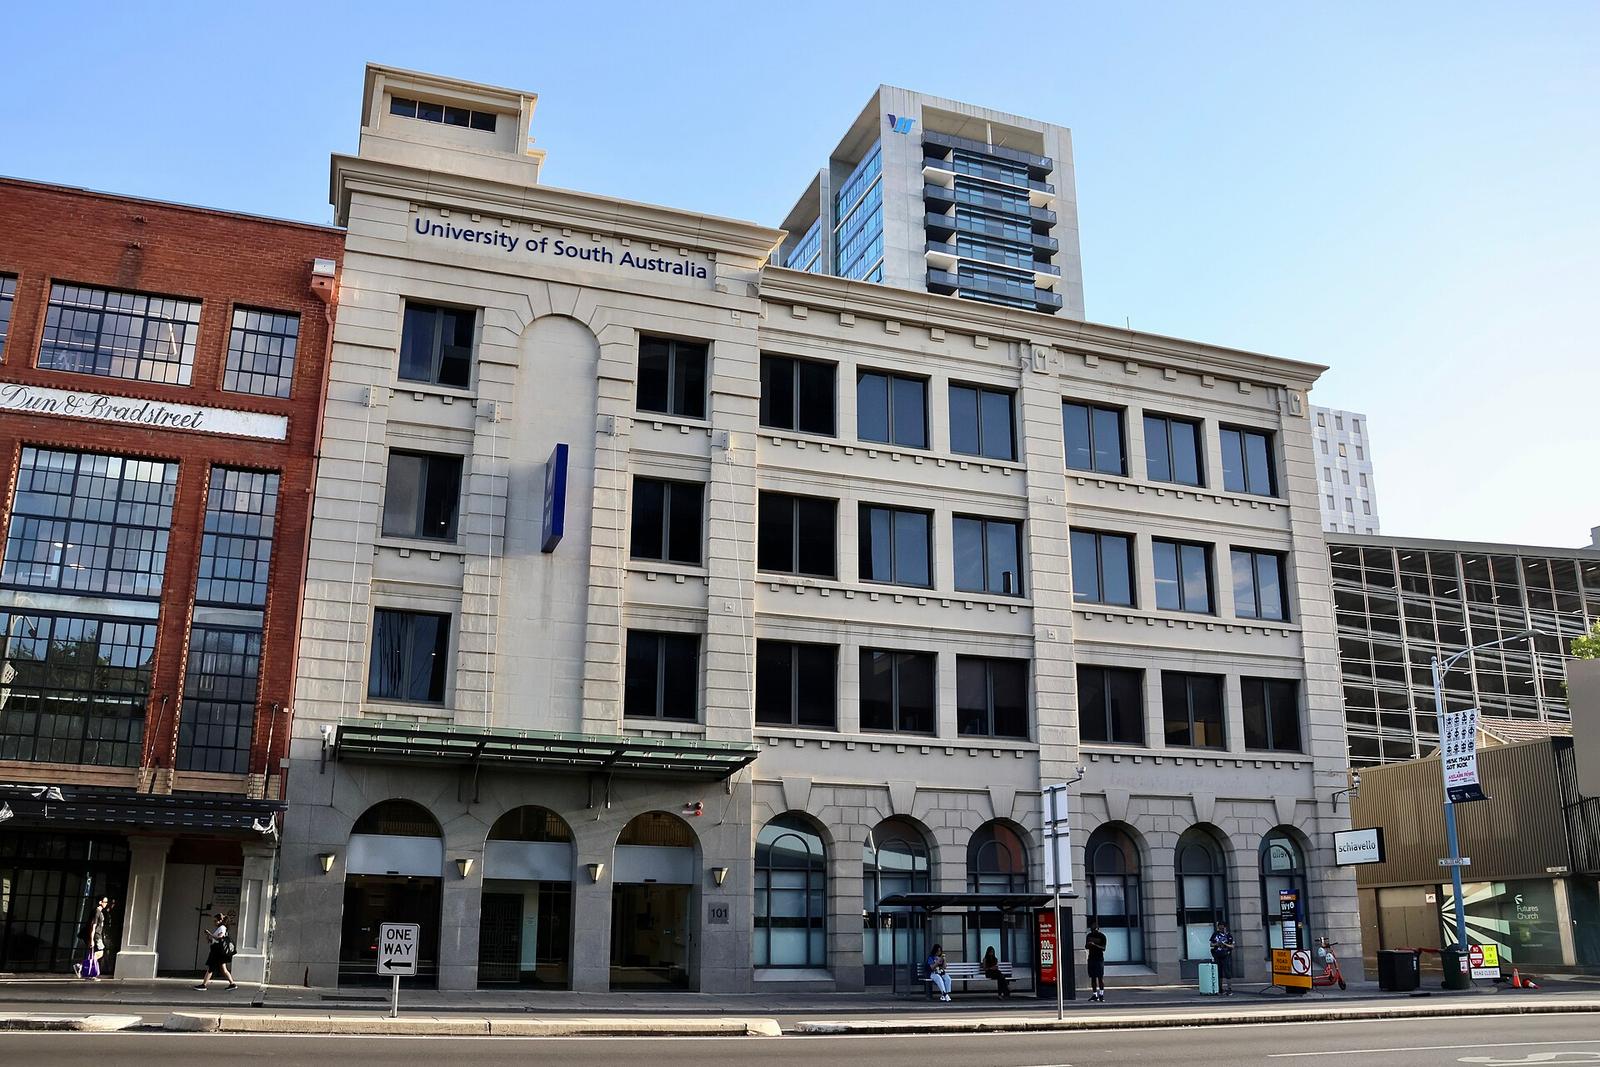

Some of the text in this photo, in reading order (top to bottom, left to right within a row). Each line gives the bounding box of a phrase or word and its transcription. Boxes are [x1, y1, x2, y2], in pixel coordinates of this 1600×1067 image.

[415, 217, 707, 279] University of South Australia
[1, 384, 204, 428] Dun & Bradstreet
[1339, 840, 1376, 852] schiavello
[711, 908, 727, 918] 101
[1517, 912, 1539, 920] Church
[386, 928, 412, 941] ONE
[384, 943, 413, 955] WAY
